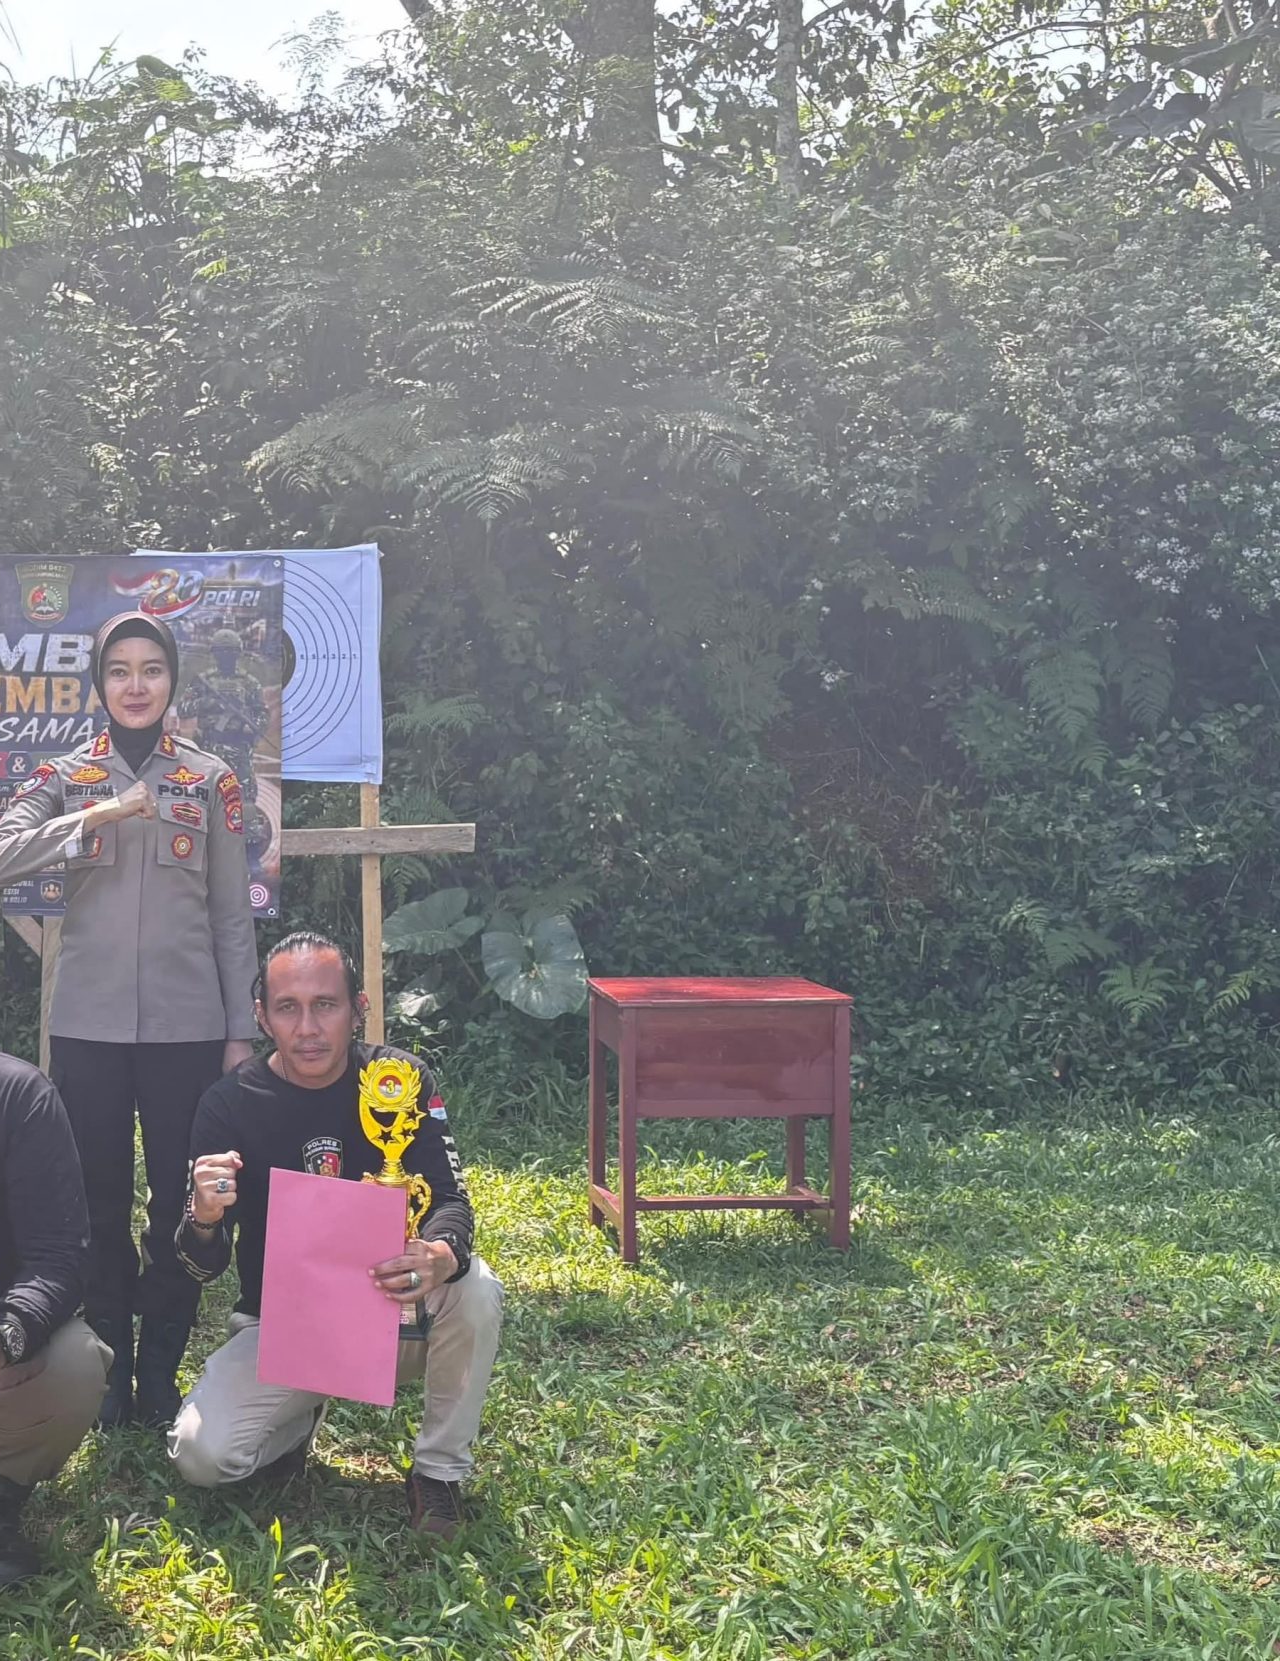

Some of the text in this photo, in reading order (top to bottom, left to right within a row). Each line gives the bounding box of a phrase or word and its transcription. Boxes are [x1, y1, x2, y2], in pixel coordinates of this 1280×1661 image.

[202, 590, 261, 607] POLRI
[11, 756, 27, 774] &
[158, 784, 209, 802] POLRI
[386, 1080, 395, 1094] 3
[307, 1139, 338, 1150] POLRES
